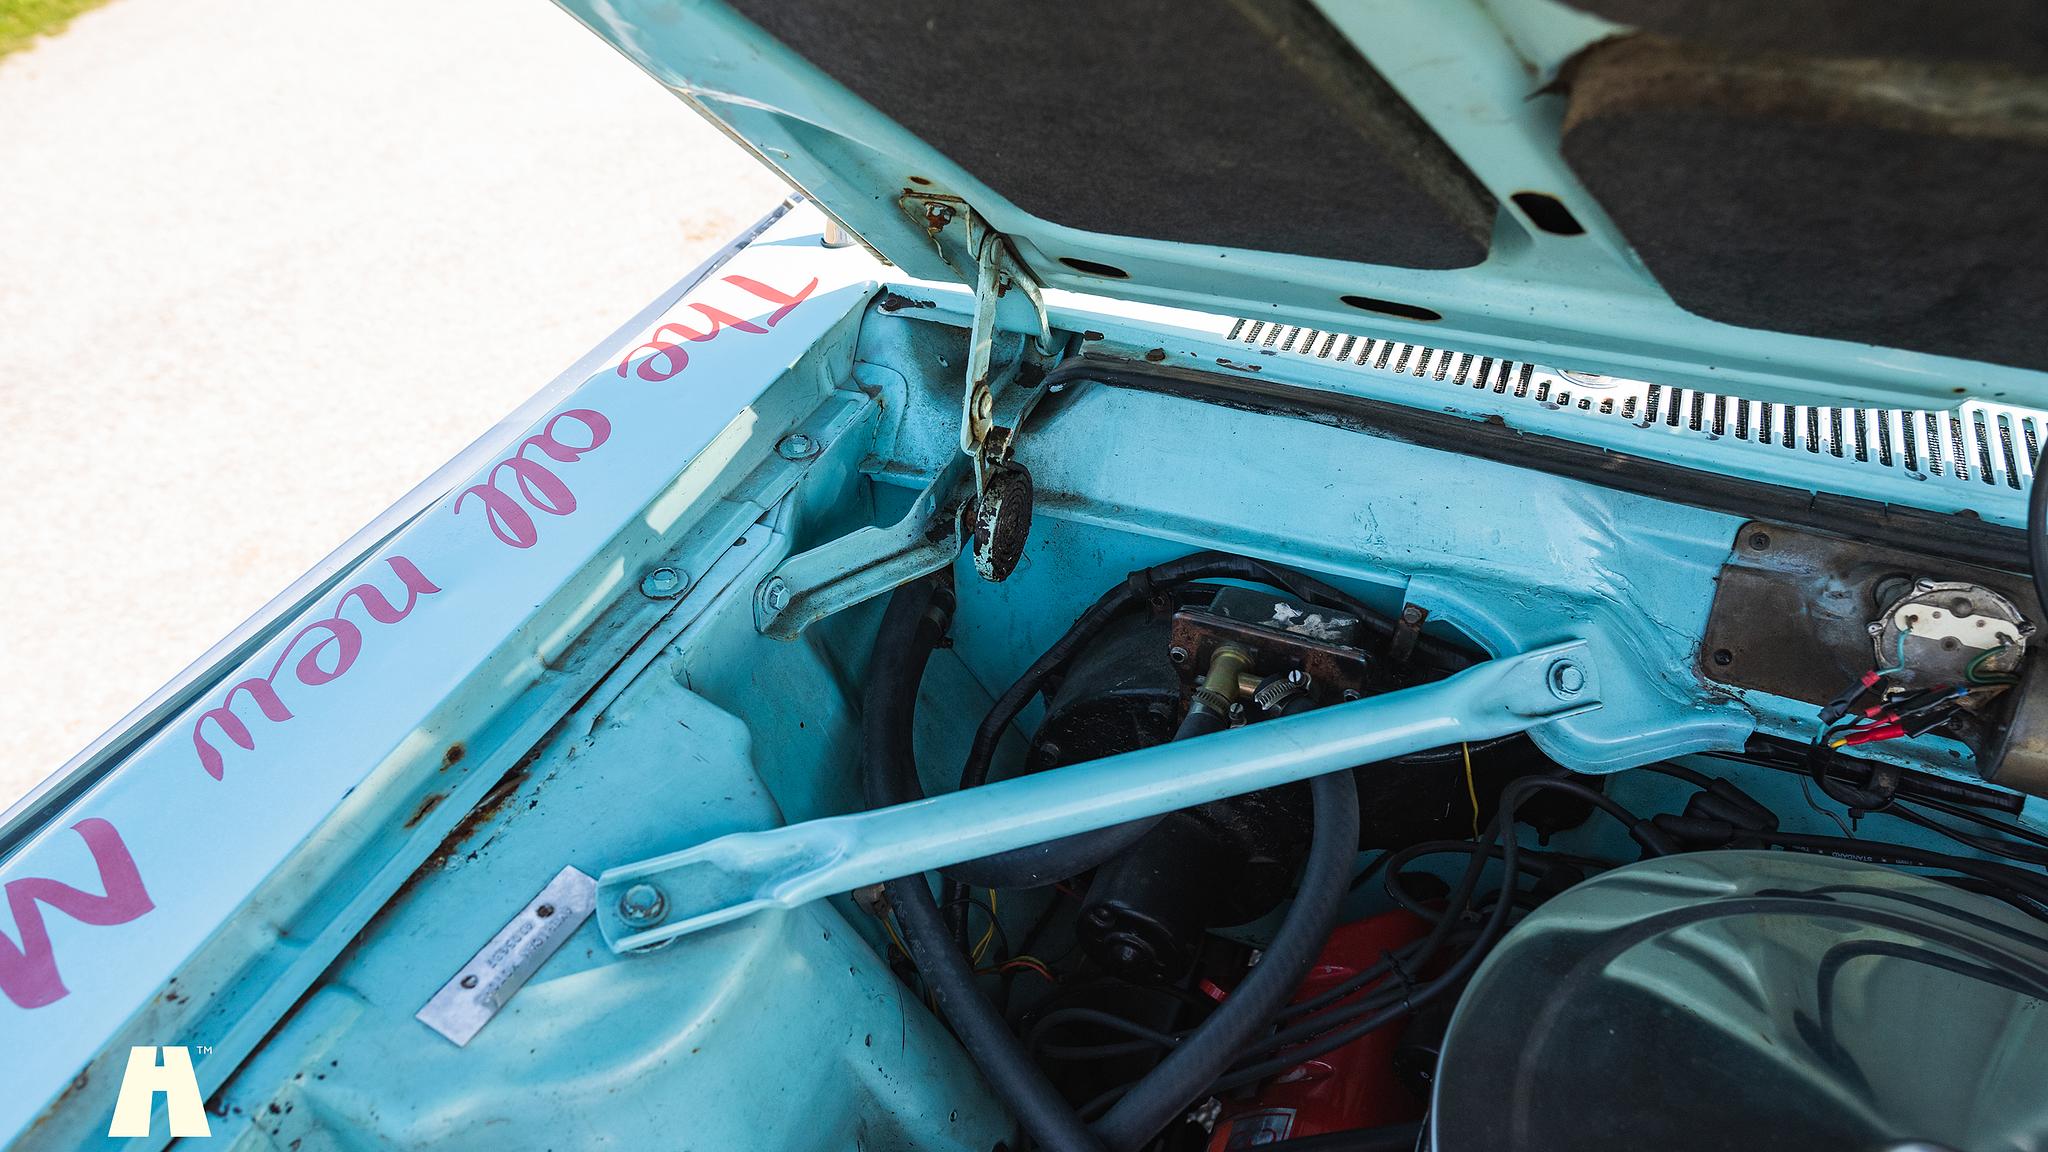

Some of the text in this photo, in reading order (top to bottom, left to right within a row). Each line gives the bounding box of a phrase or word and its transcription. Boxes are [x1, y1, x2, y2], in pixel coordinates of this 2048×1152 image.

[619, 274, 819, 382] The
[454, 409, 612, 549] all
[193, 555, 442, 782] new
